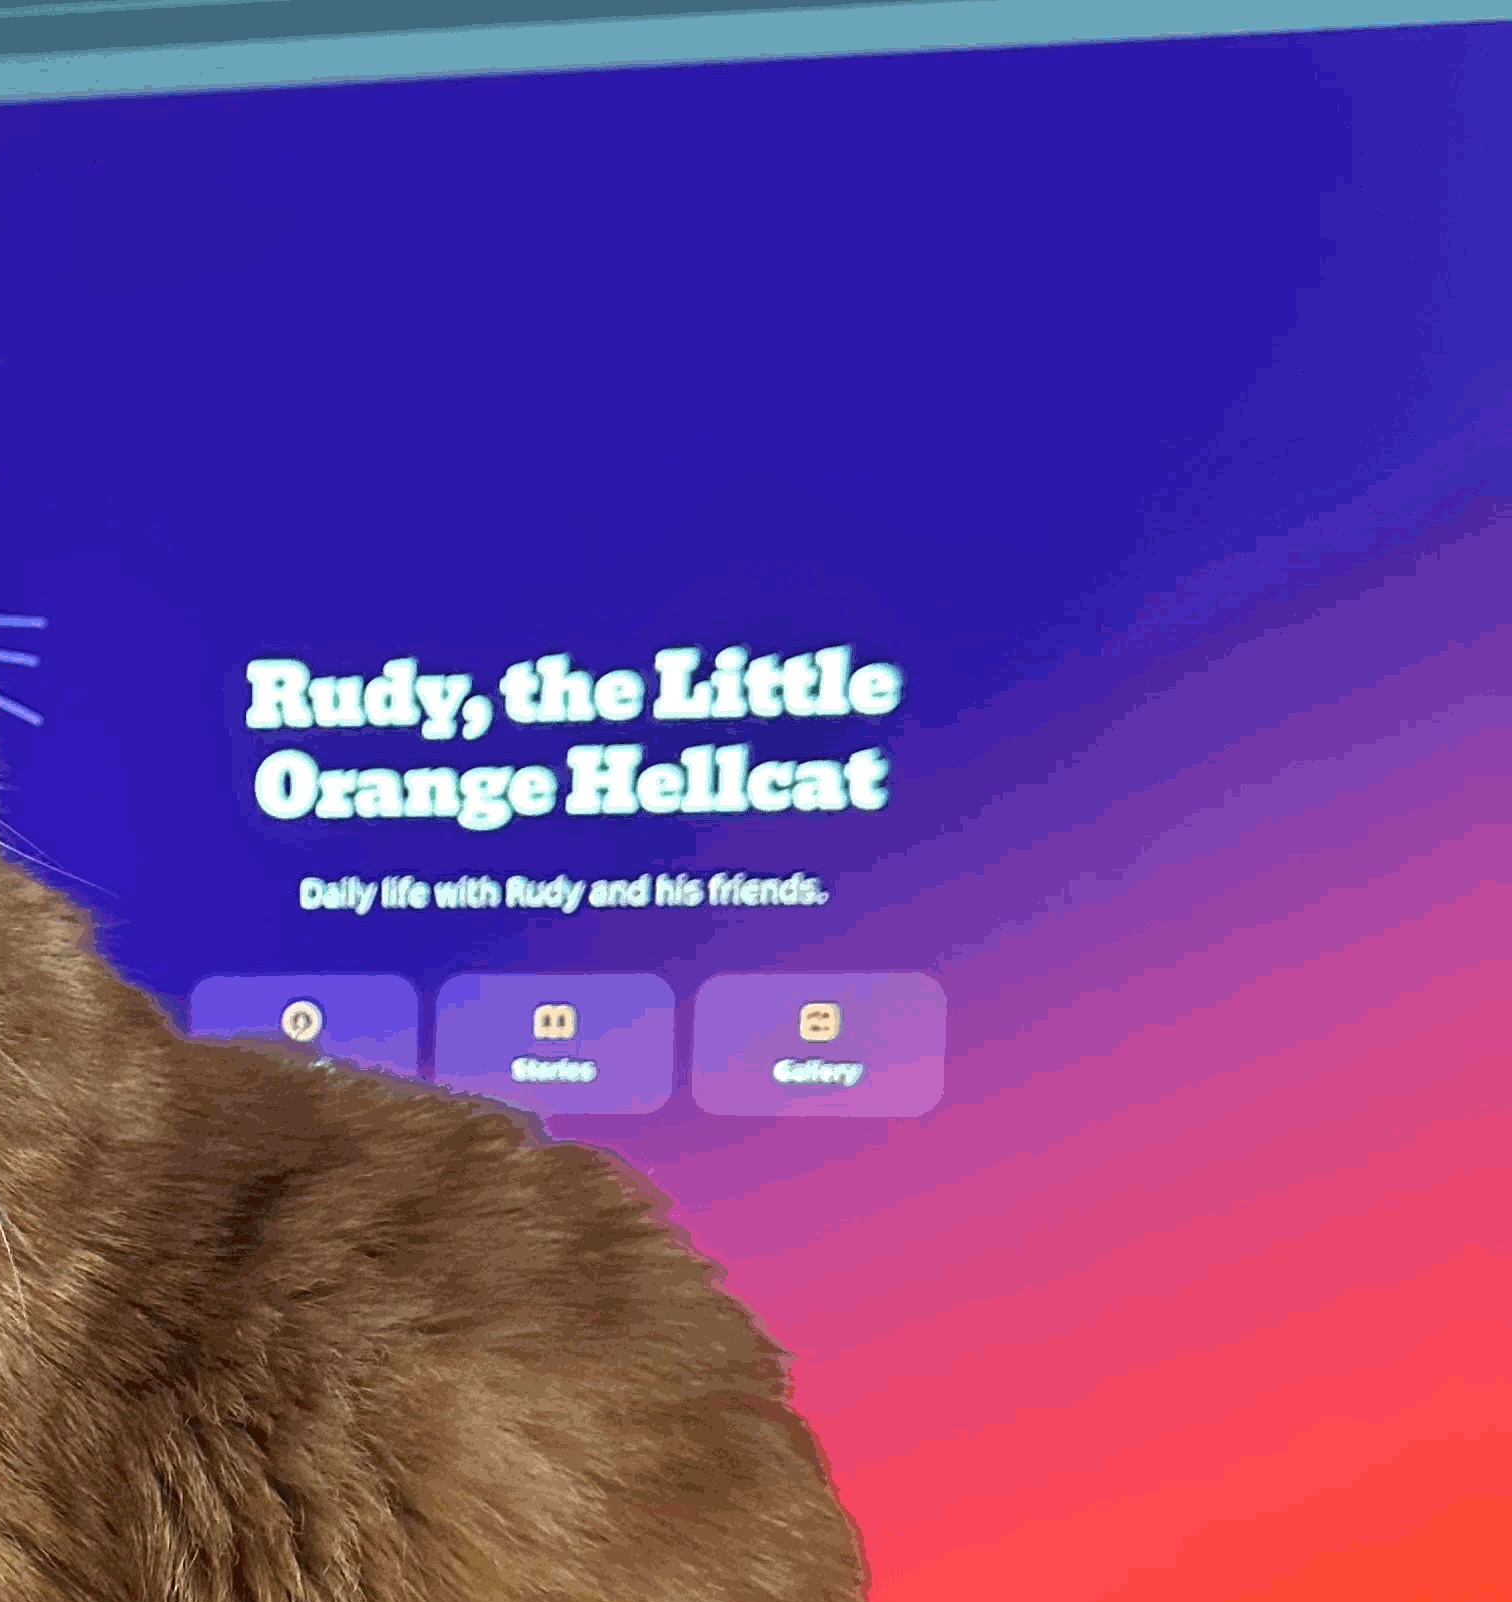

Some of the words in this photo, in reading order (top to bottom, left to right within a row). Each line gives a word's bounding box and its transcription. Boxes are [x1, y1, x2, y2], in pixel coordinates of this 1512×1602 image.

[245, 657, 493, 740] Rudy,
[500, 652, 644, 723] the
[652, 645, 900, 720] Little
[254, 749, 557, 830] Orange
[565, 743, 888, 815] Hellcat
[299, 875, 379, 915] Daily
[381, 875, 431, 909] life
[433, 875, 503, 909] with
[505, 874, 586, 914] Rudy
[588, 873, 652, 908] and
[655, 873, 705, 907] his
[708, 872, 829, 906] friends.
